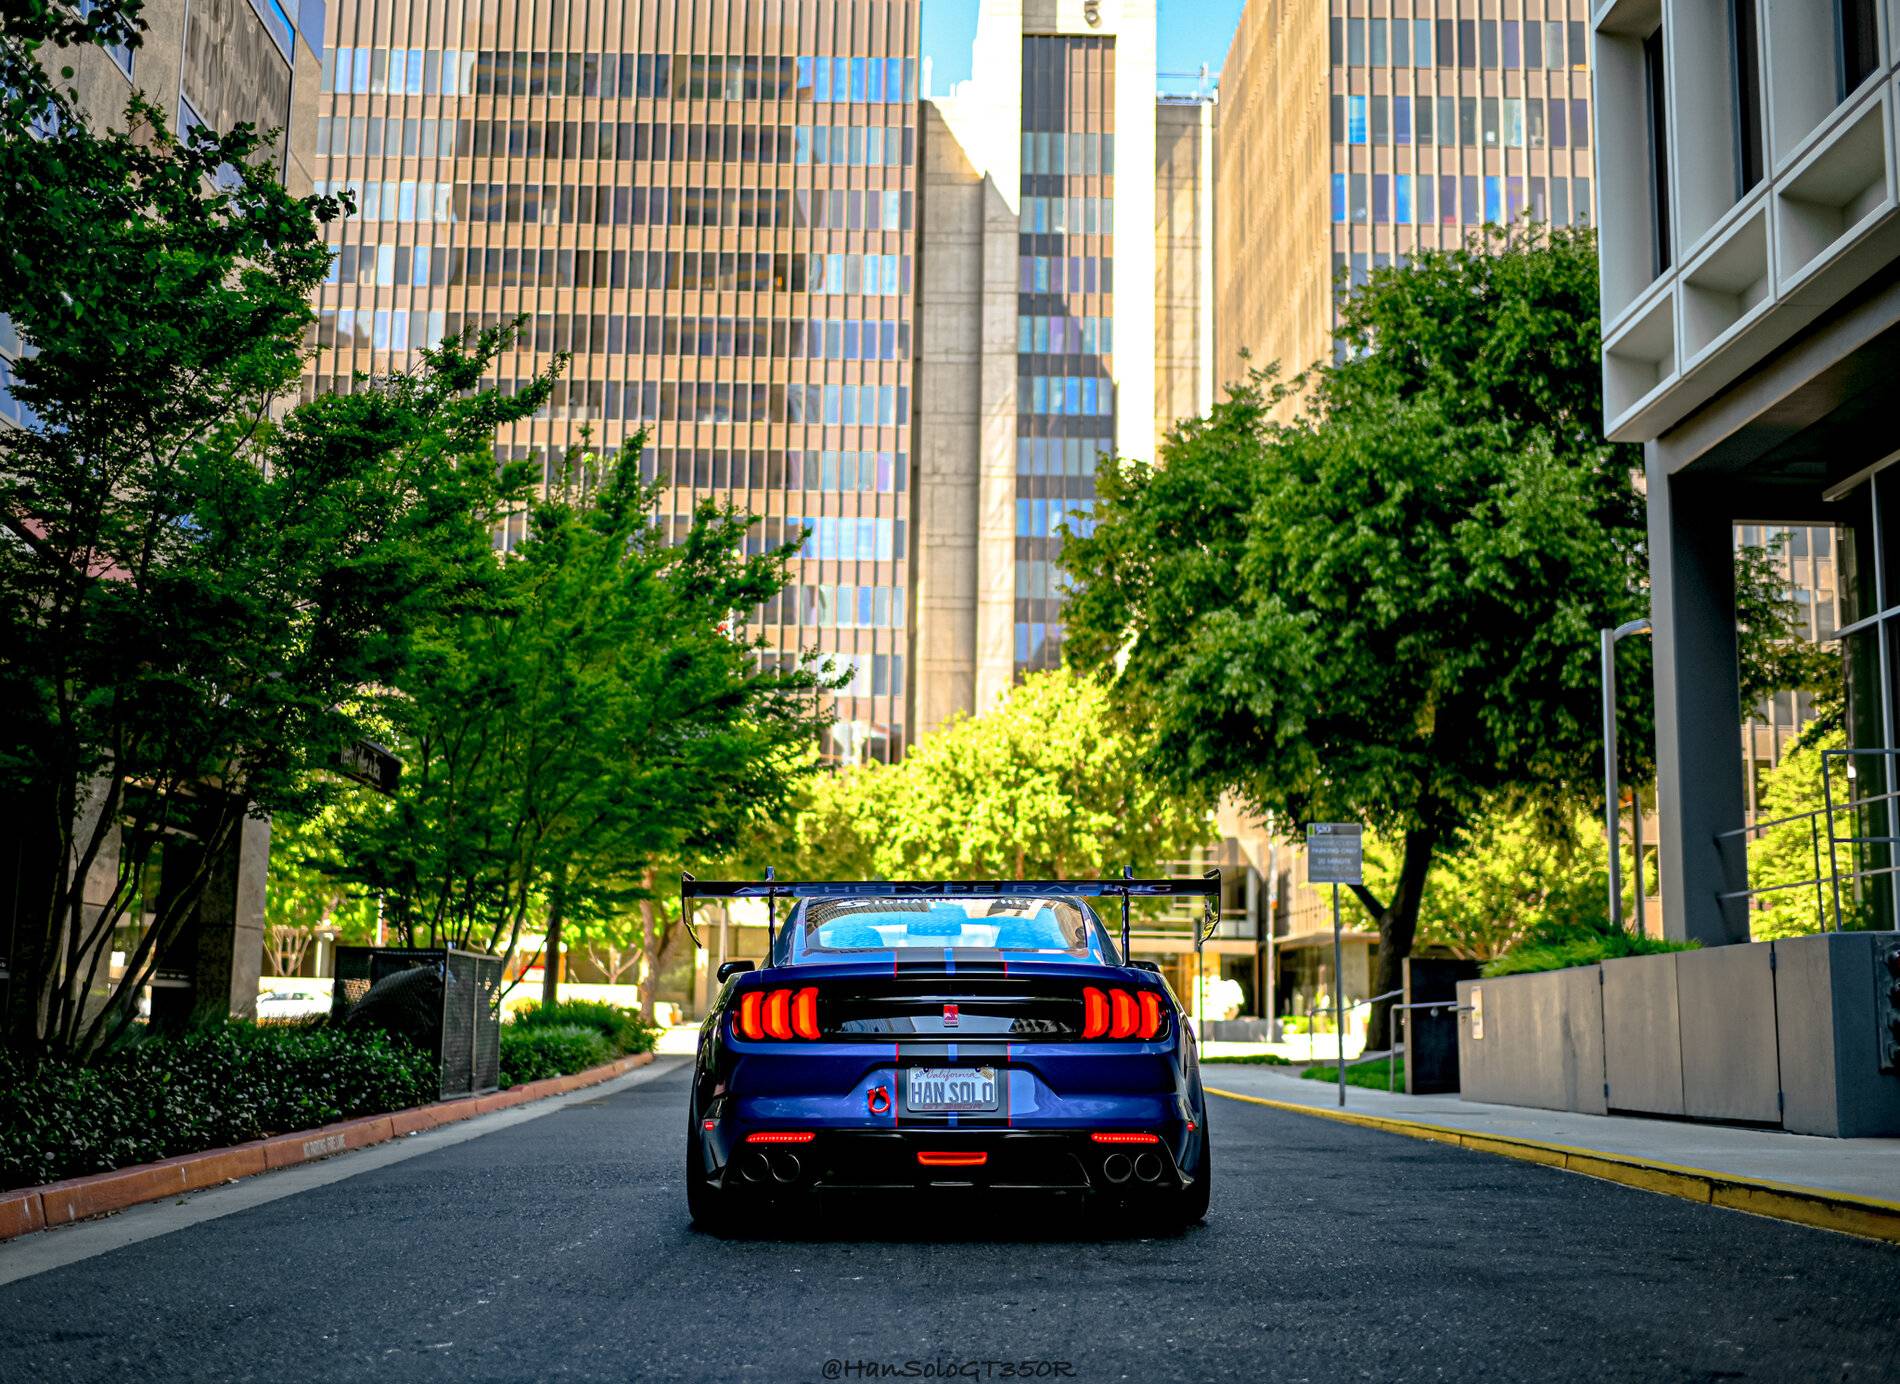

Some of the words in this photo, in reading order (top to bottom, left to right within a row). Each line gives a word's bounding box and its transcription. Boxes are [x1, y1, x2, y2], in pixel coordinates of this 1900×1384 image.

[926, 1067, 979, 1081] California
[911, 1082, 945, 1103] HAN
[948, 1081, 993, 1104] SOLO
